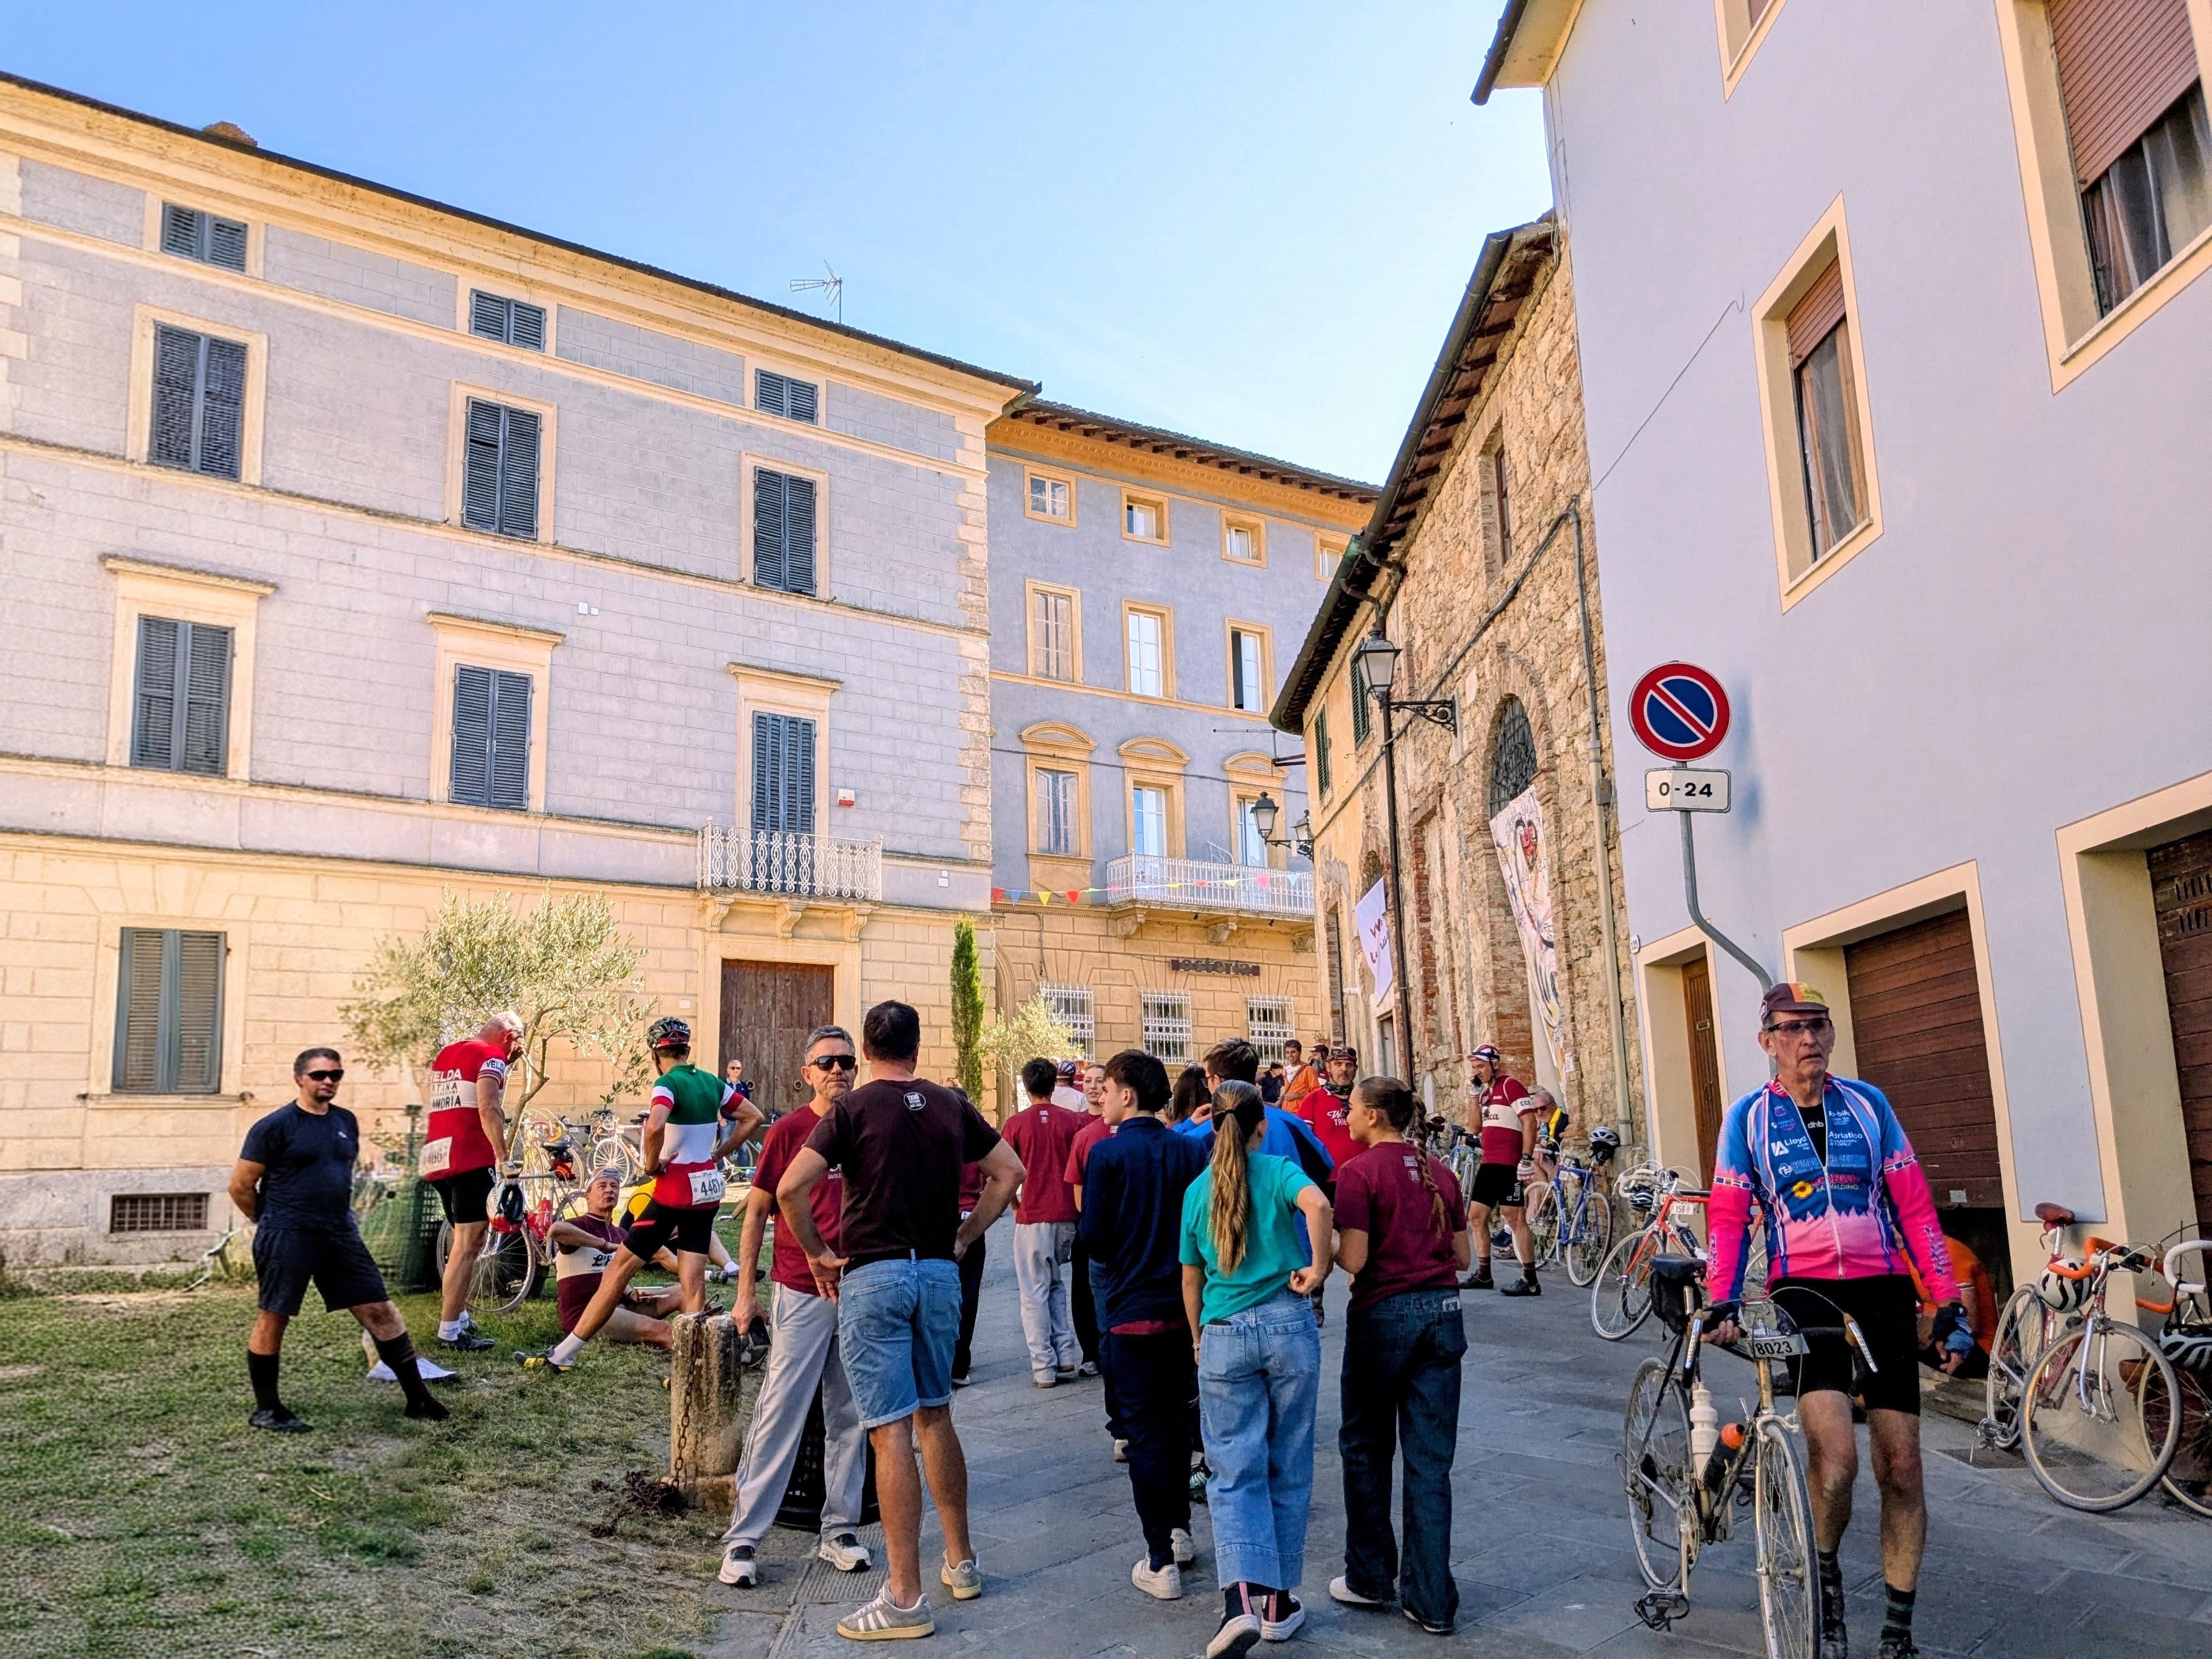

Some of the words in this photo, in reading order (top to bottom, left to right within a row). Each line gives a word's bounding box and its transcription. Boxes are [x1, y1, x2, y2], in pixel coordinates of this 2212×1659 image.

[1784, 1135, 1807, 1146] Lloyd
[1828, 1131, 1863, 1139] Adriatico
[1675, 1205, 1685, 1213] 156
[1755, 1341, 1793, 1355] 8023
